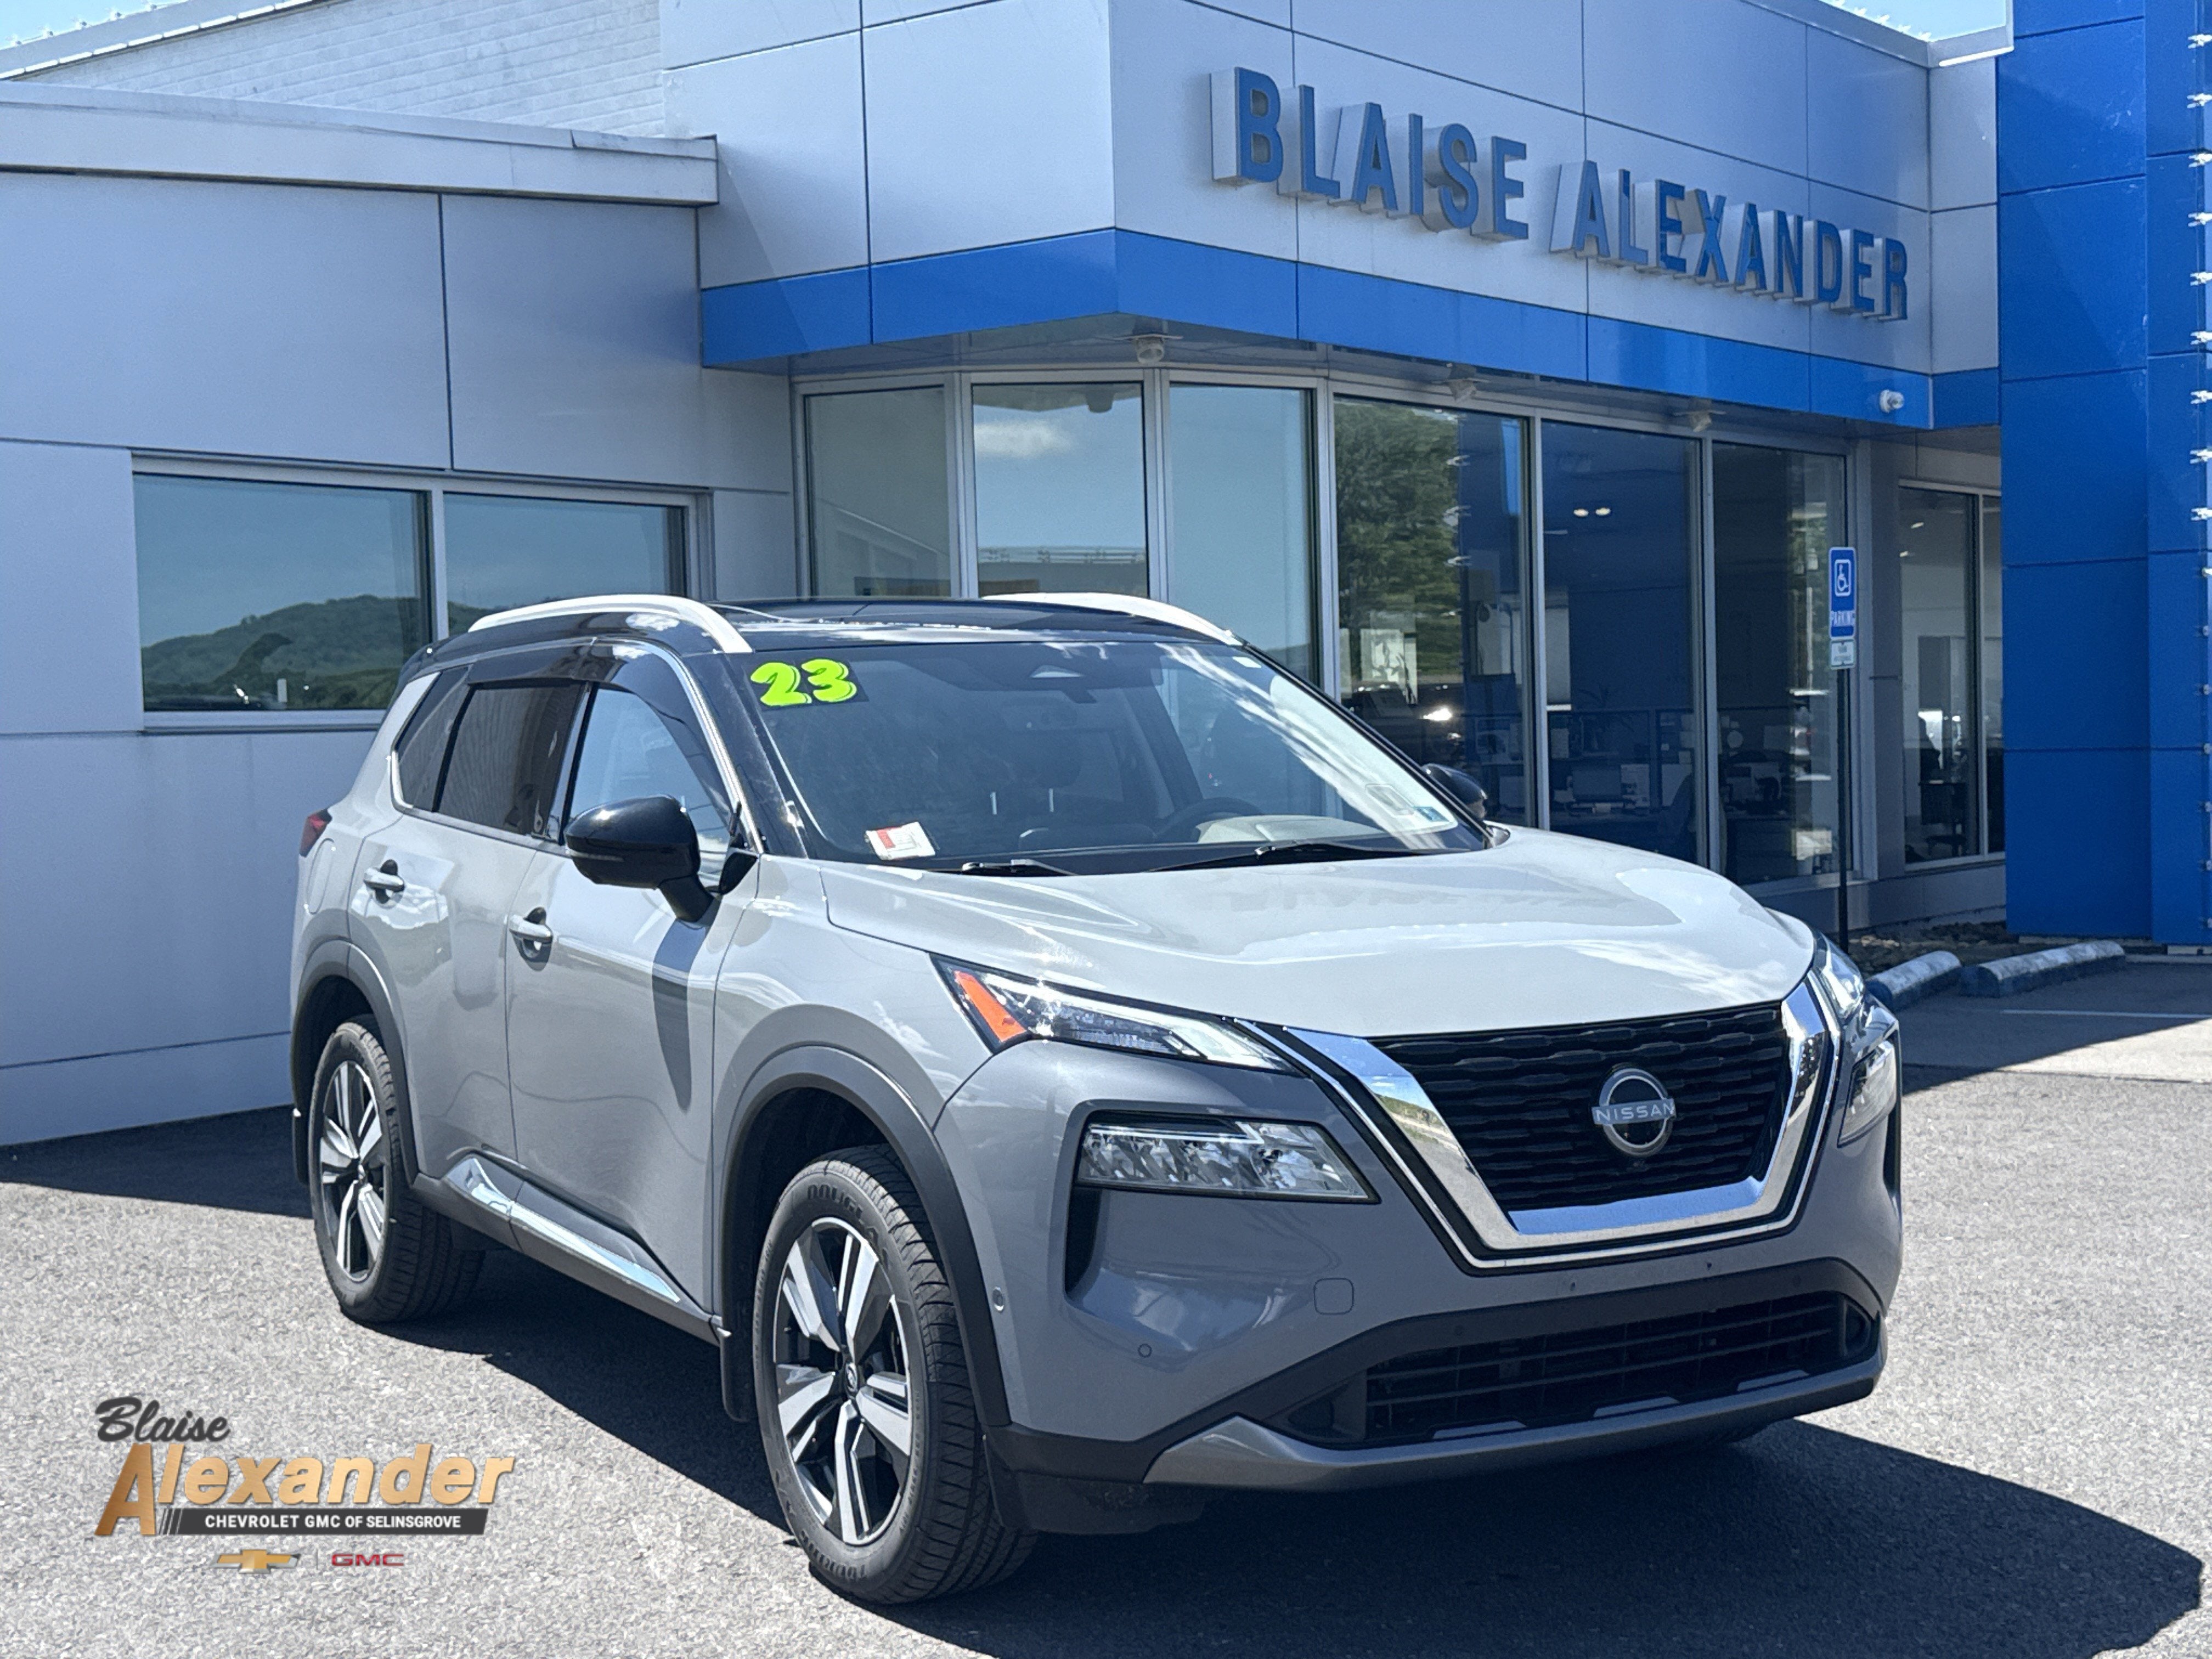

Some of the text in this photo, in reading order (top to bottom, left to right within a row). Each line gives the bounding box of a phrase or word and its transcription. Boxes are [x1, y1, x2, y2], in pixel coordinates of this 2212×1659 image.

[1233, 66, 1908, 320] BLAISE ALEXANDER
[750, 658, 857, 707] 23
[1595, 1103, 1674, 1122] NISSAN
